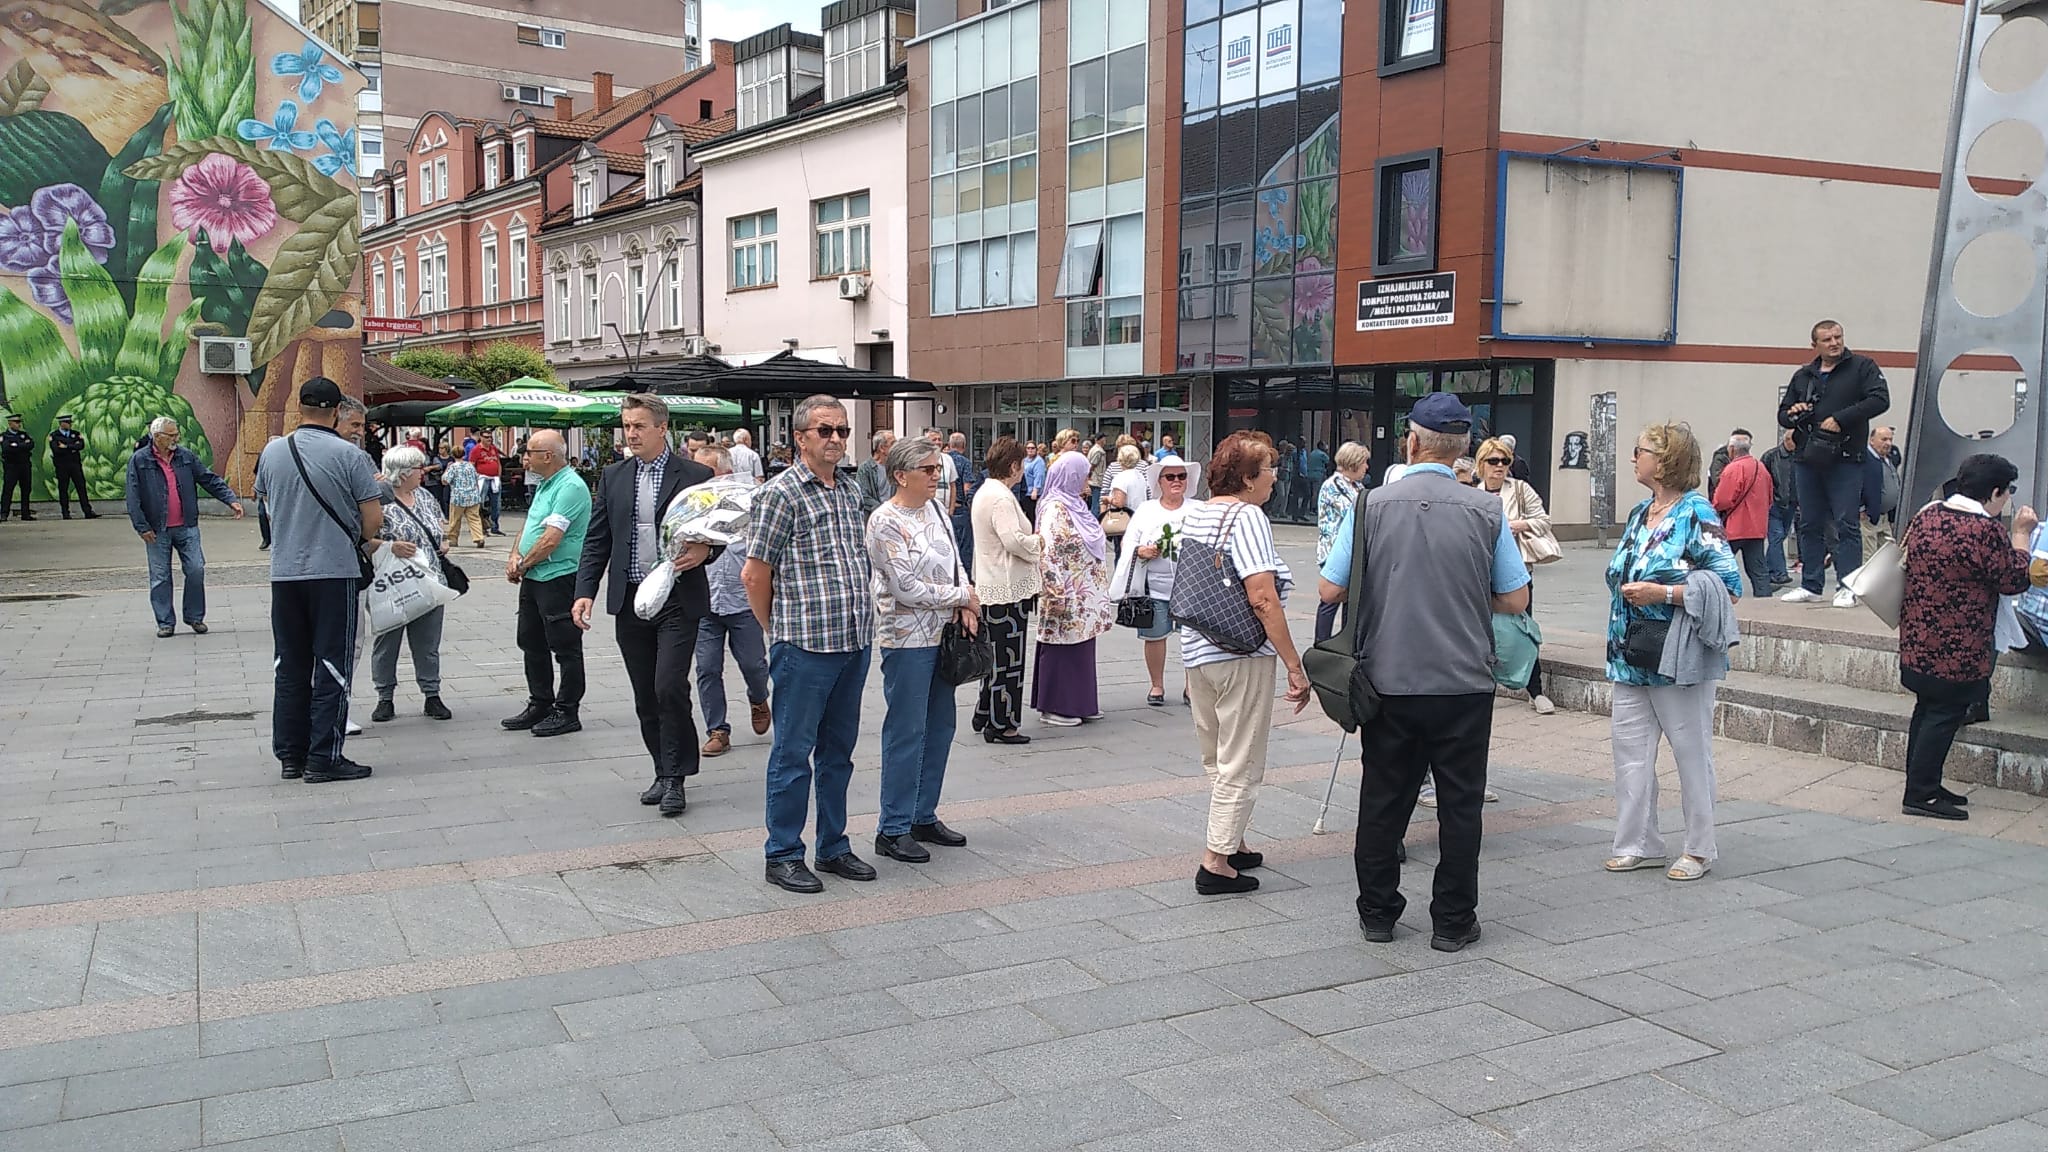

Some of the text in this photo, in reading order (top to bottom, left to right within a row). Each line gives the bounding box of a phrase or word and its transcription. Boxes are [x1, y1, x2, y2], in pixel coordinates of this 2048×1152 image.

[1409, 0, 1434, 15] ПН
[1266, 28, 1292, 50] ПНП
[1227, 39, 1251, 60] ПНП
[1378, 280, 1434, 294] IZNAJMLJUJE SE
[1362, 291, 1450, 306] KOMPLET POSLOVNA ZGRADA
[1396, 305, 1405, 313] PO
[1361, 320, 1386, 328] KONTAKT
[1386, 318, 1409, 327] TELEFON
[663, 396, 716, 405] itinka
